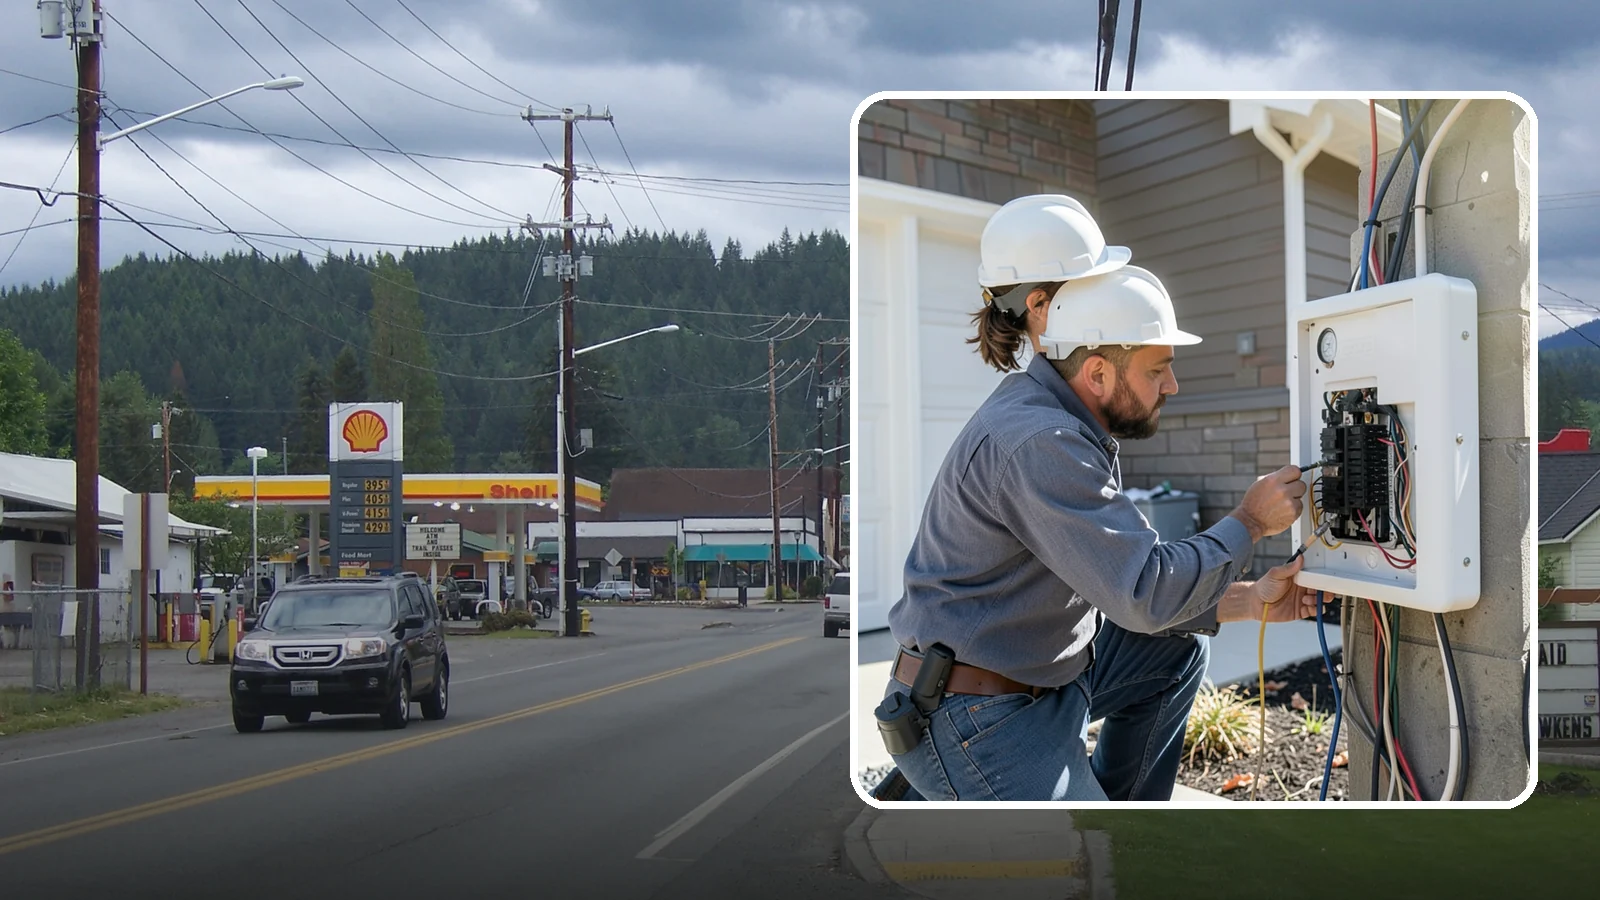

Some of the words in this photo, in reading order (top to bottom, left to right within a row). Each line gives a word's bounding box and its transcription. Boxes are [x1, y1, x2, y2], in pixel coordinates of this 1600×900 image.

[365, 480, 384, 490] 395
[490, 484, 547, 499] Shell
[365, 494, 384, 504] 405
[365, 508, 384, 518] 415
[365, 522, 384, 533] 429
[1538, 642, 1567, 666] AID
